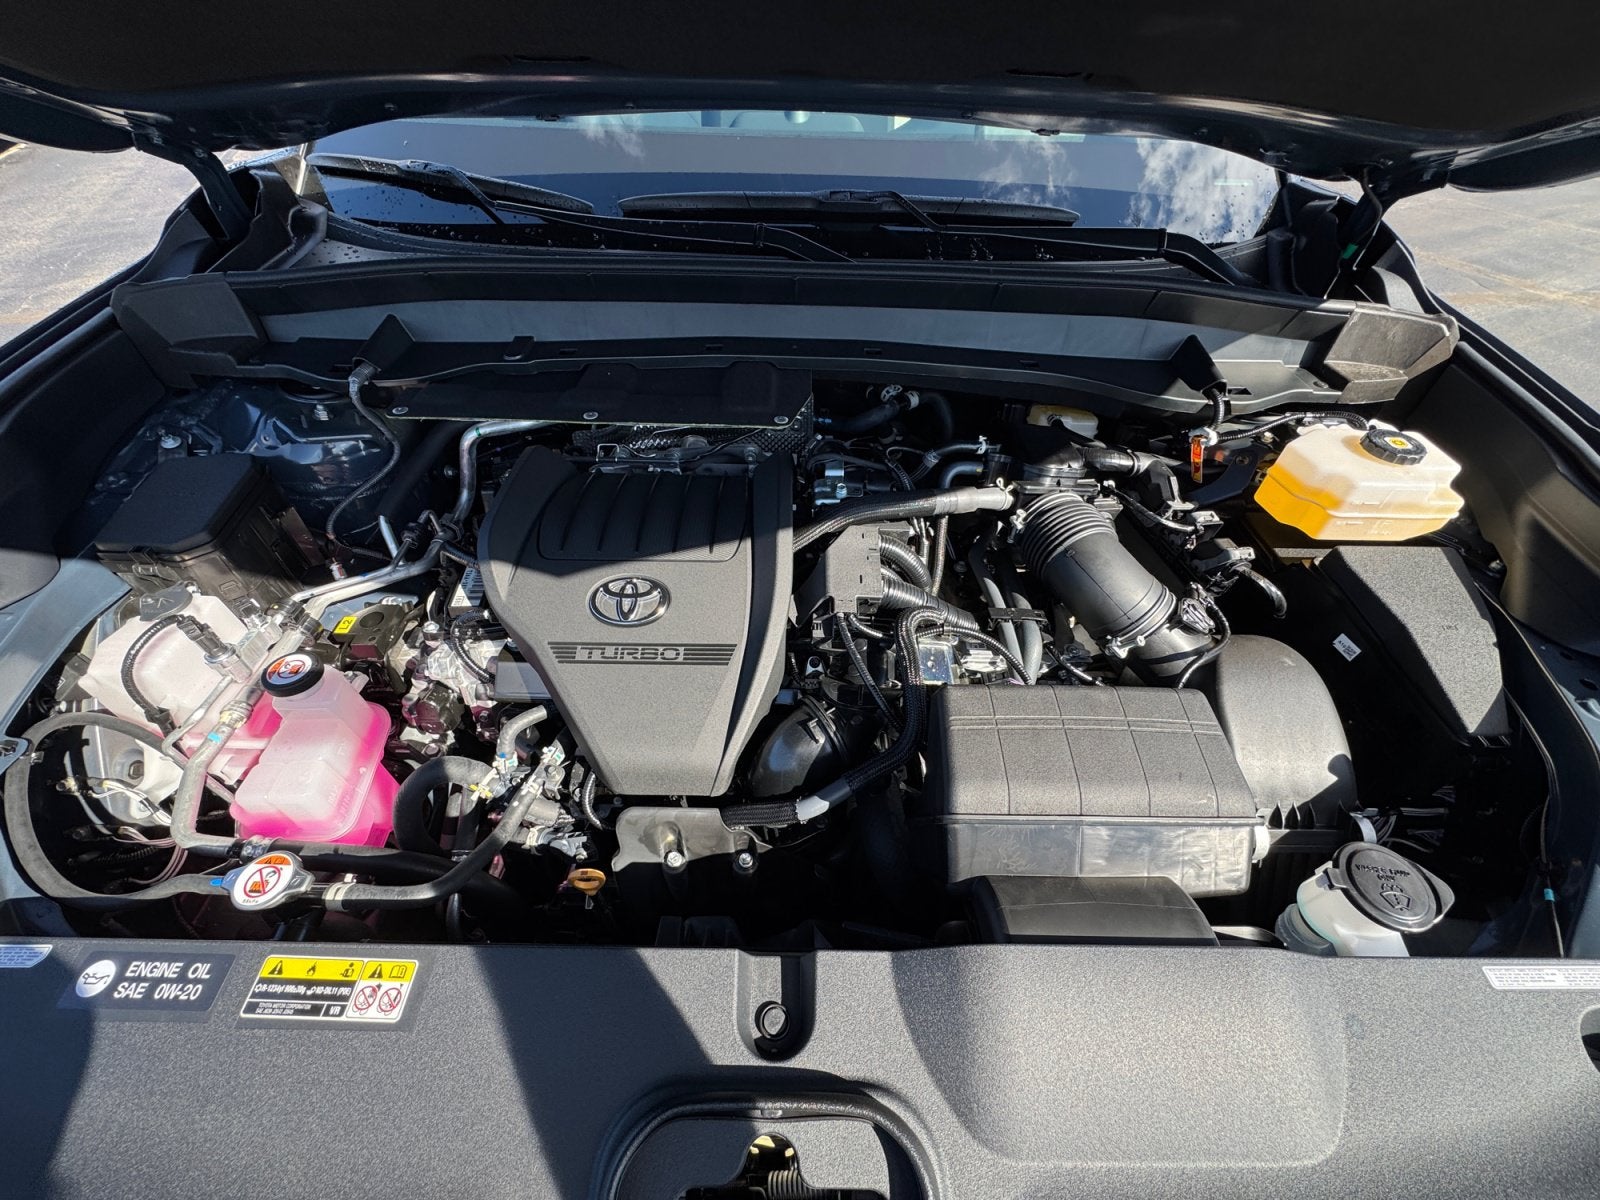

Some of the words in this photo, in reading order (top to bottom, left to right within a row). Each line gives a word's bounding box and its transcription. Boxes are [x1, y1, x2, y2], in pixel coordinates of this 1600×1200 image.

[579, 646, 681, 661] TURBO
[125, 961, 184, 978] ENGINE
[187, 962, 211, 979] OIL
[113, 982, 149, 999] SAE
[153, 983, 203, 1001] 0W-20
